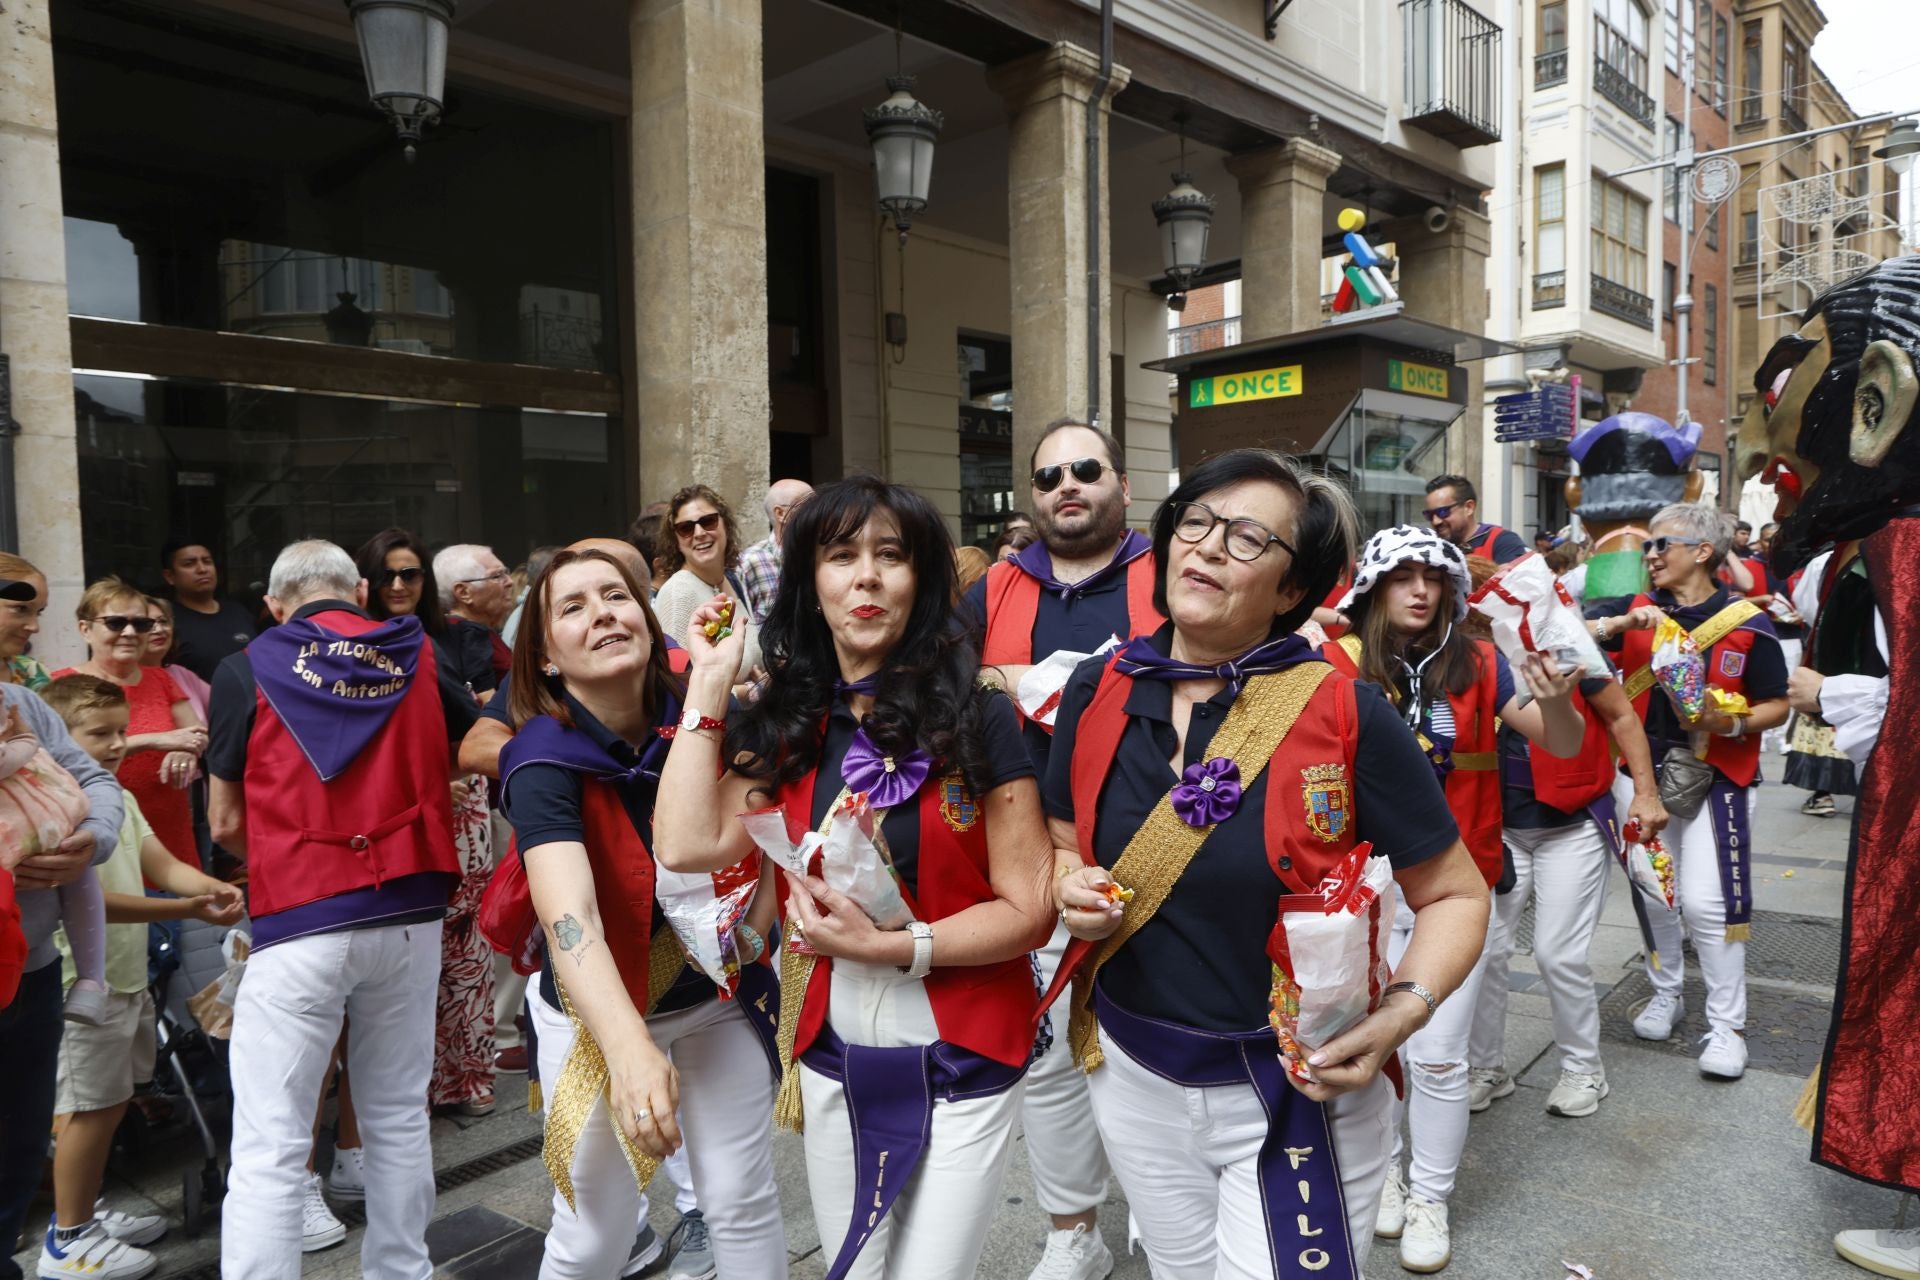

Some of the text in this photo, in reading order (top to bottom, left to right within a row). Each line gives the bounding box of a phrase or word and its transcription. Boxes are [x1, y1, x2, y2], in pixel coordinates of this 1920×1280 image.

[1223, 371, 1292, 398] ONCE
[1407, 367, 1443, 392] ONCE
[298, 641, 319, 658] LA
[292, 658, 405, 699] San Antonio
[1283, 1146, 1330, 1271] FILO
